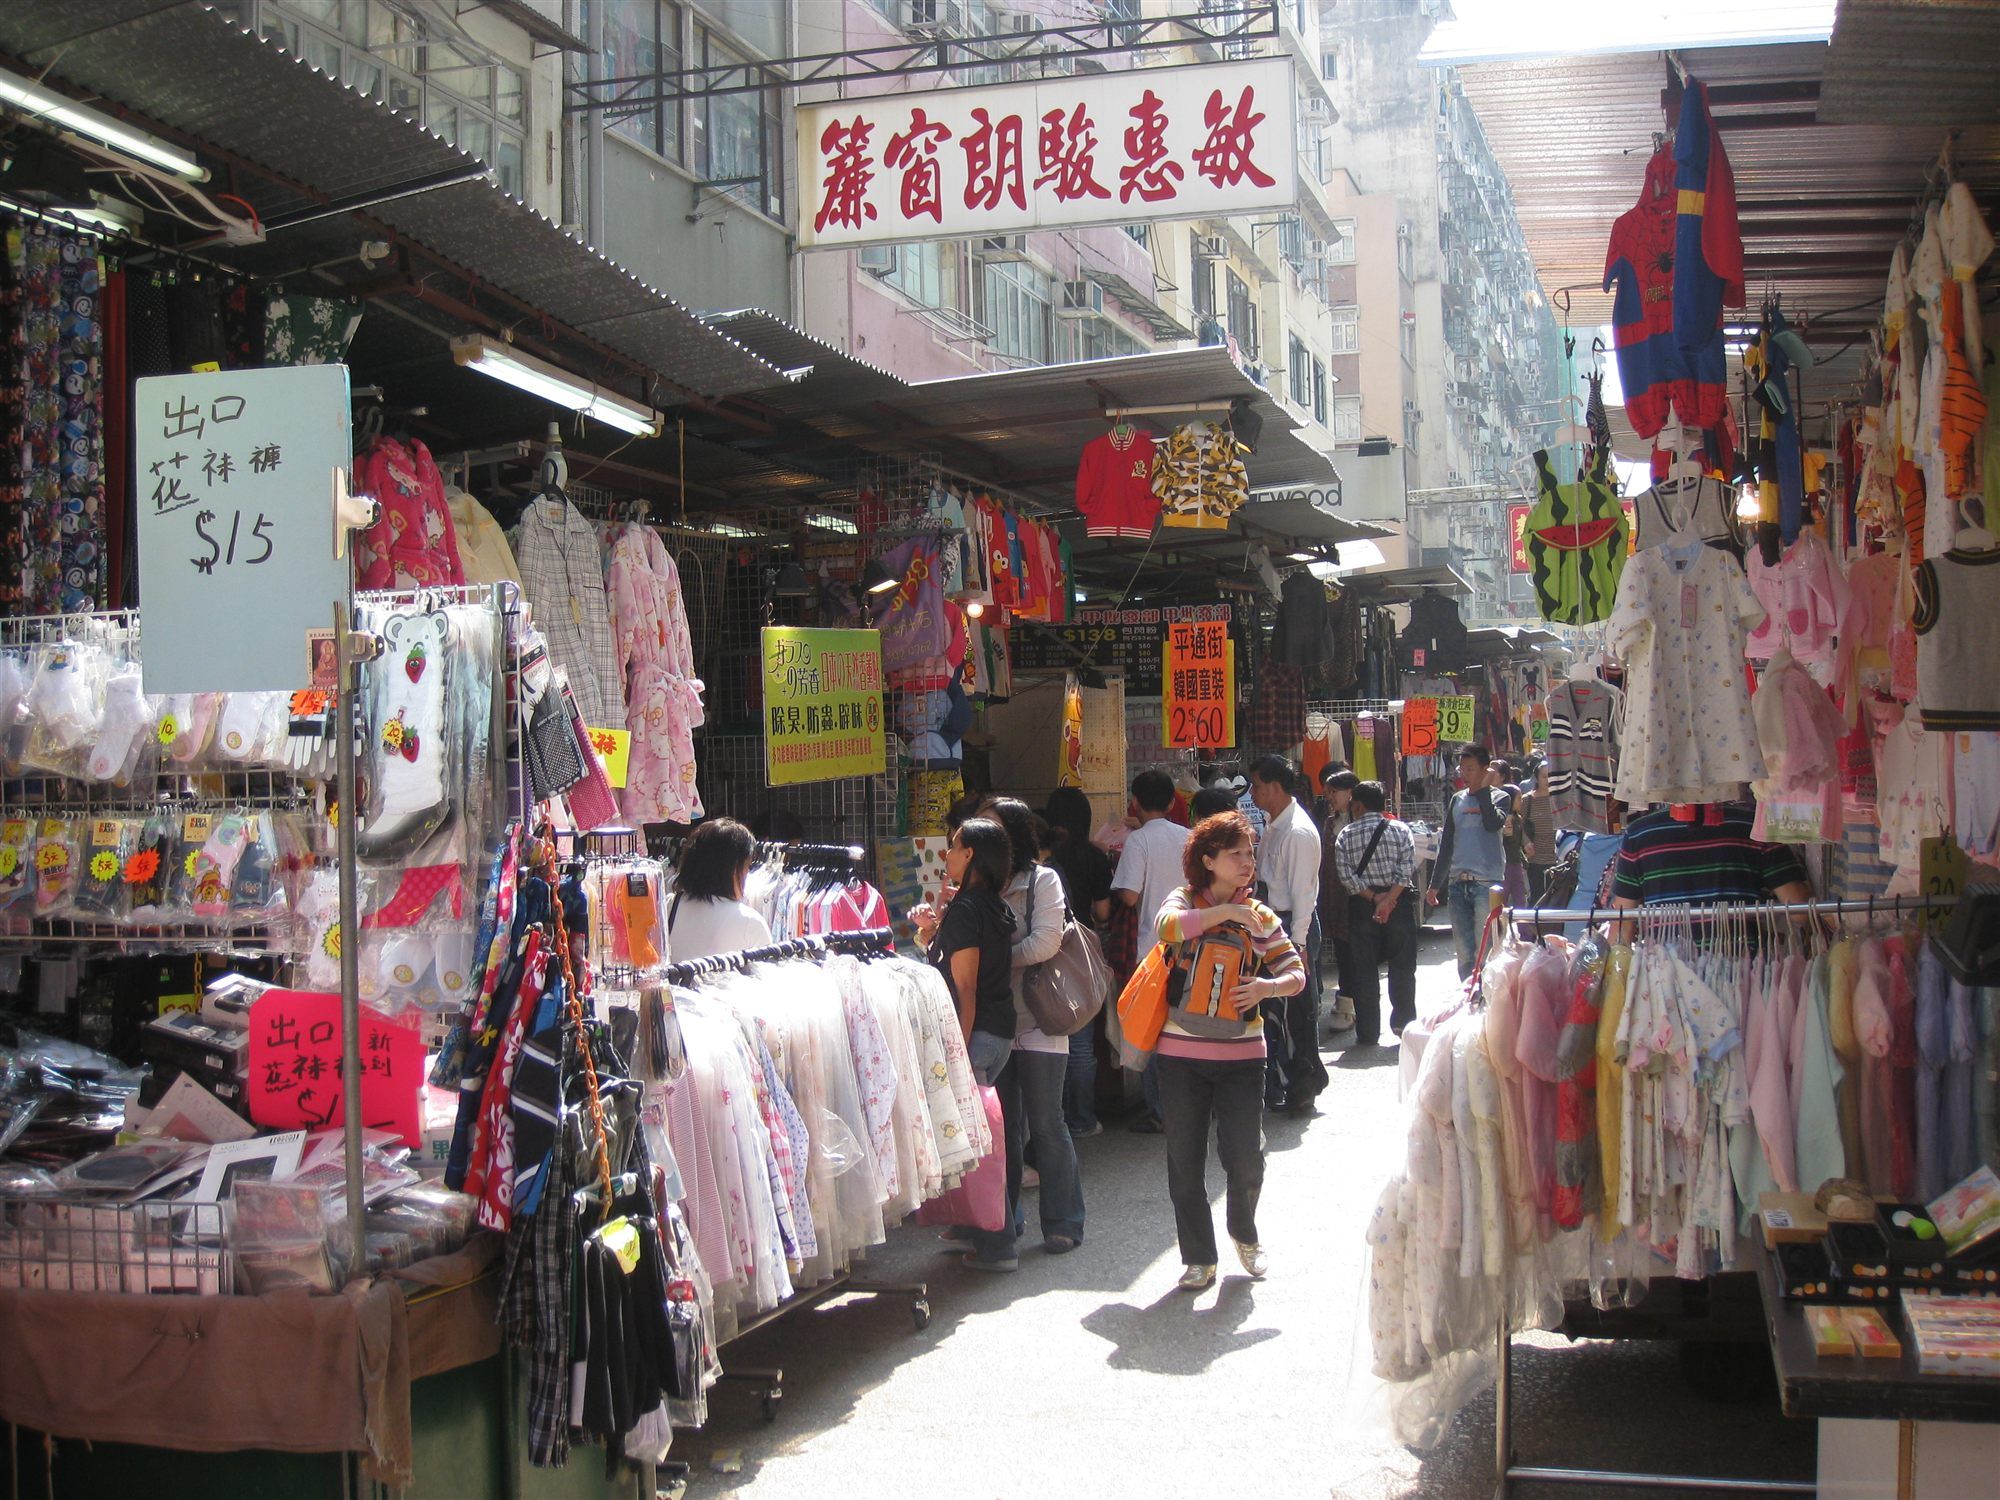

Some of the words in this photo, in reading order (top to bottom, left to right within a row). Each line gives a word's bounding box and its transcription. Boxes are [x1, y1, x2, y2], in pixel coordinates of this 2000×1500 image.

[163, 395, 246, 440] 出口
[190, 510, 274, 575] $15
[1063, 624, 1118, 642] $138
[1173, 626, 1222, 661] 平通街
[1173, 667, 1224, 702] 韓國童裝
[1408, 723, 1434, 748] 15
[267, 1013, 334, 1049] 出口
